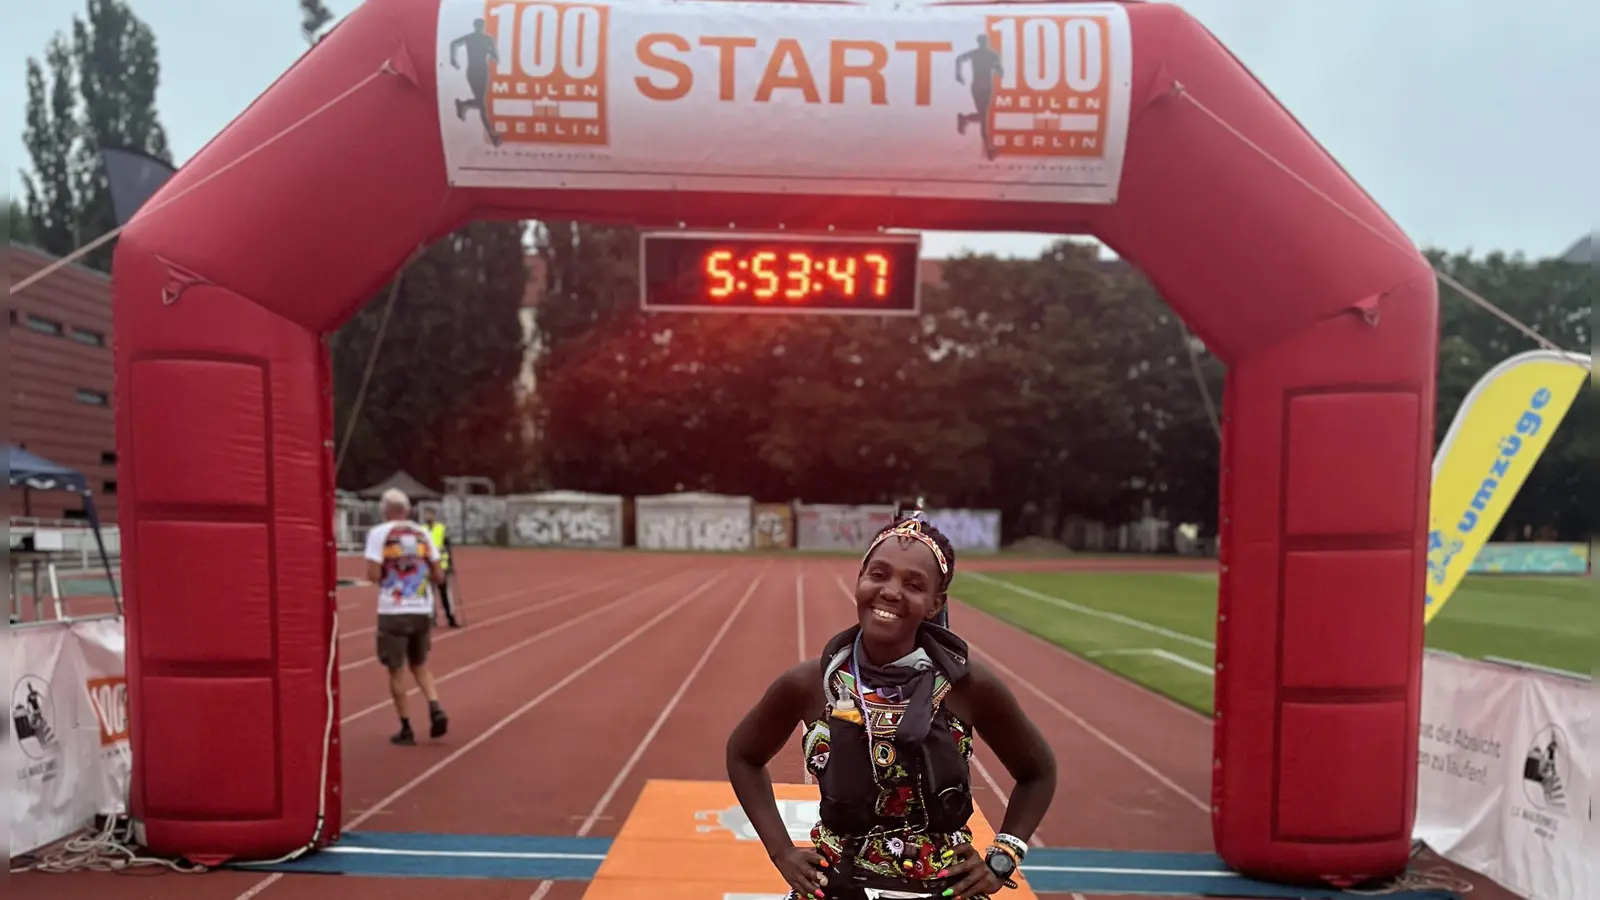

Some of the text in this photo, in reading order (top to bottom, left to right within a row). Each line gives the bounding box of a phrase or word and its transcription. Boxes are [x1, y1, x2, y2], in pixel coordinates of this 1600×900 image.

[489, 4, 599, 79] 100
[991, 18, 1102, 92] 100
[634, 32, 953, 107] START
[492, 81, 599, 97] MEILEN
[995, 95, 1100, 110] MEILEN
[494, 120, 600, 137] BERLIN
[993, 134, 1097, 149] BERLIN
[706, 250, 888, 299] 5:53:47
[1457, 387, 1551, 533] umzüge
[1454, 727, 1501, 758] Absicht
[1447, 753, 1488, 787] laufen!
